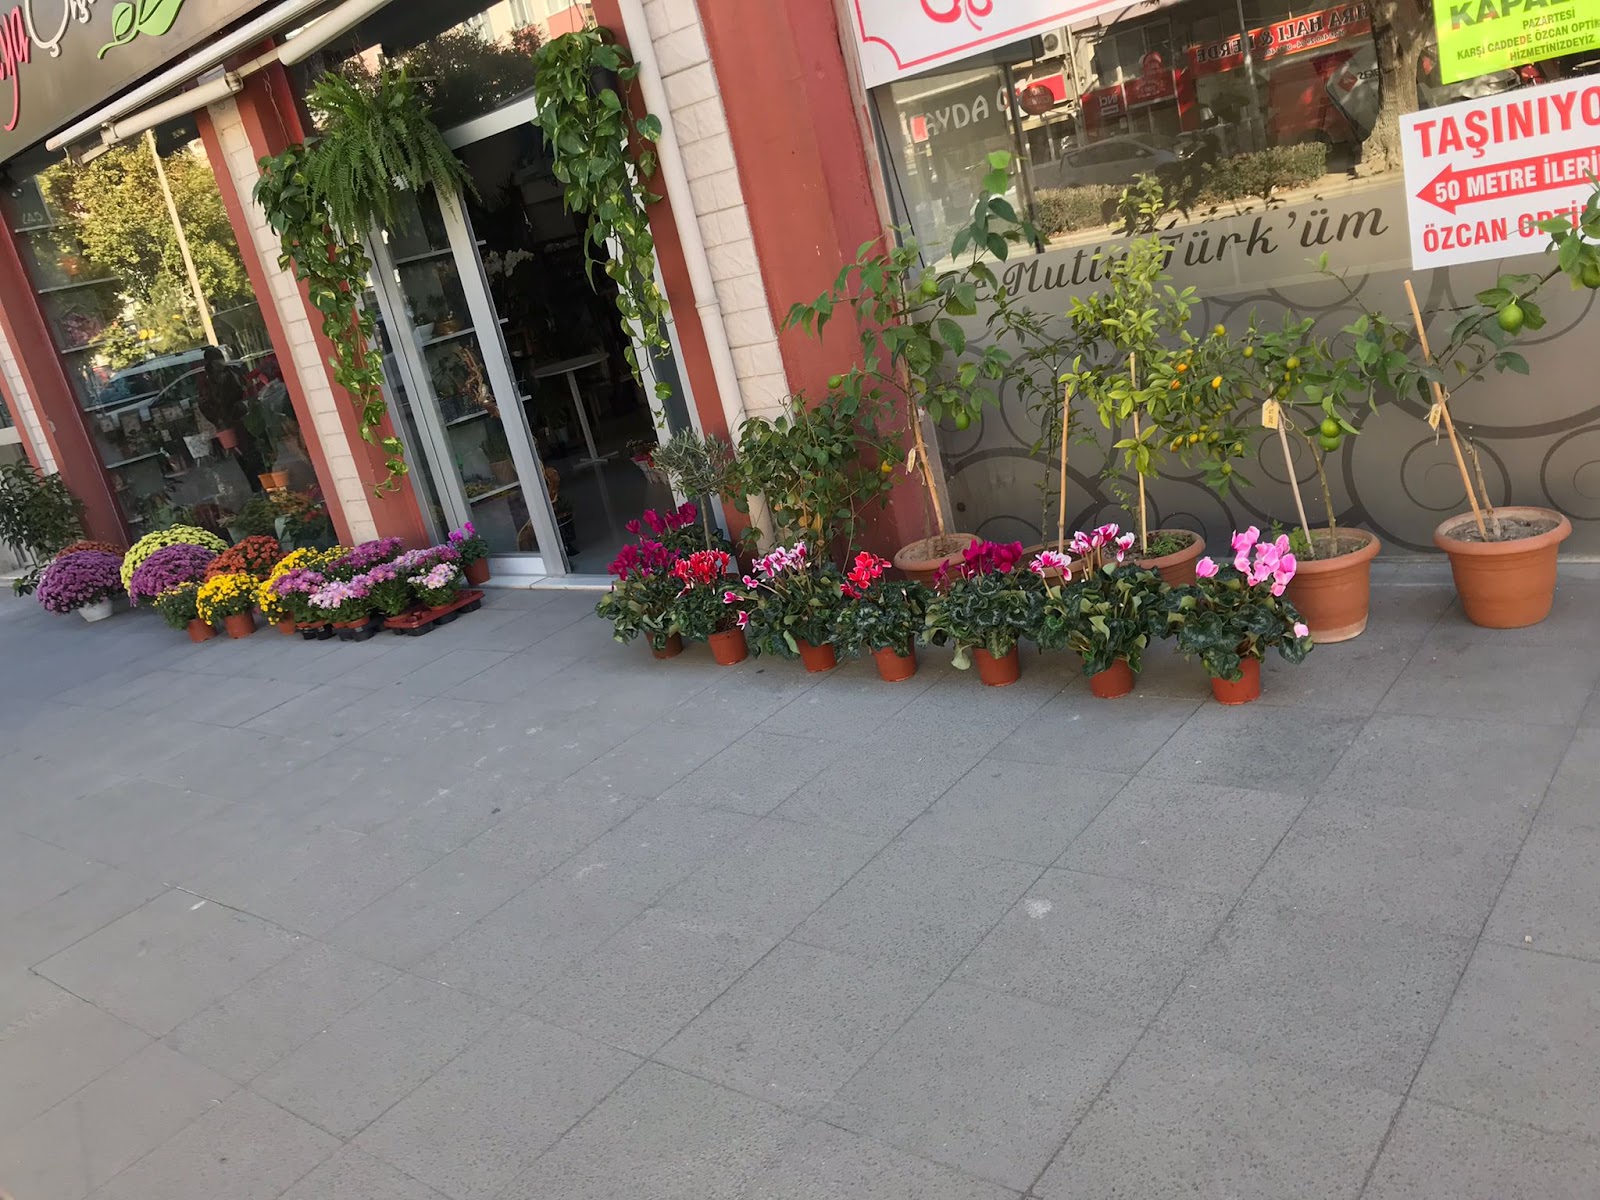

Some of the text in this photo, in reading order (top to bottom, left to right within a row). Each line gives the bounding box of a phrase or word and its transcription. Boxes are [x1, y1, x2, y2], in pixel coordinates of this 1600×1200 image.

[1522, 7, 1576, 30] PAZARTESİ
[1487, 34, 1532, 53] CADDEDE
[1535, 25, 1569, 42] ÖZCAN
[1510, 33, 1596, 61] HİZMETİNİZDEYİZ
[1435, 181, 1461, 204] 50
[1466, 165, 1537, 198] METRE
[1423, 216, 1508, 253] ÖZCAN
